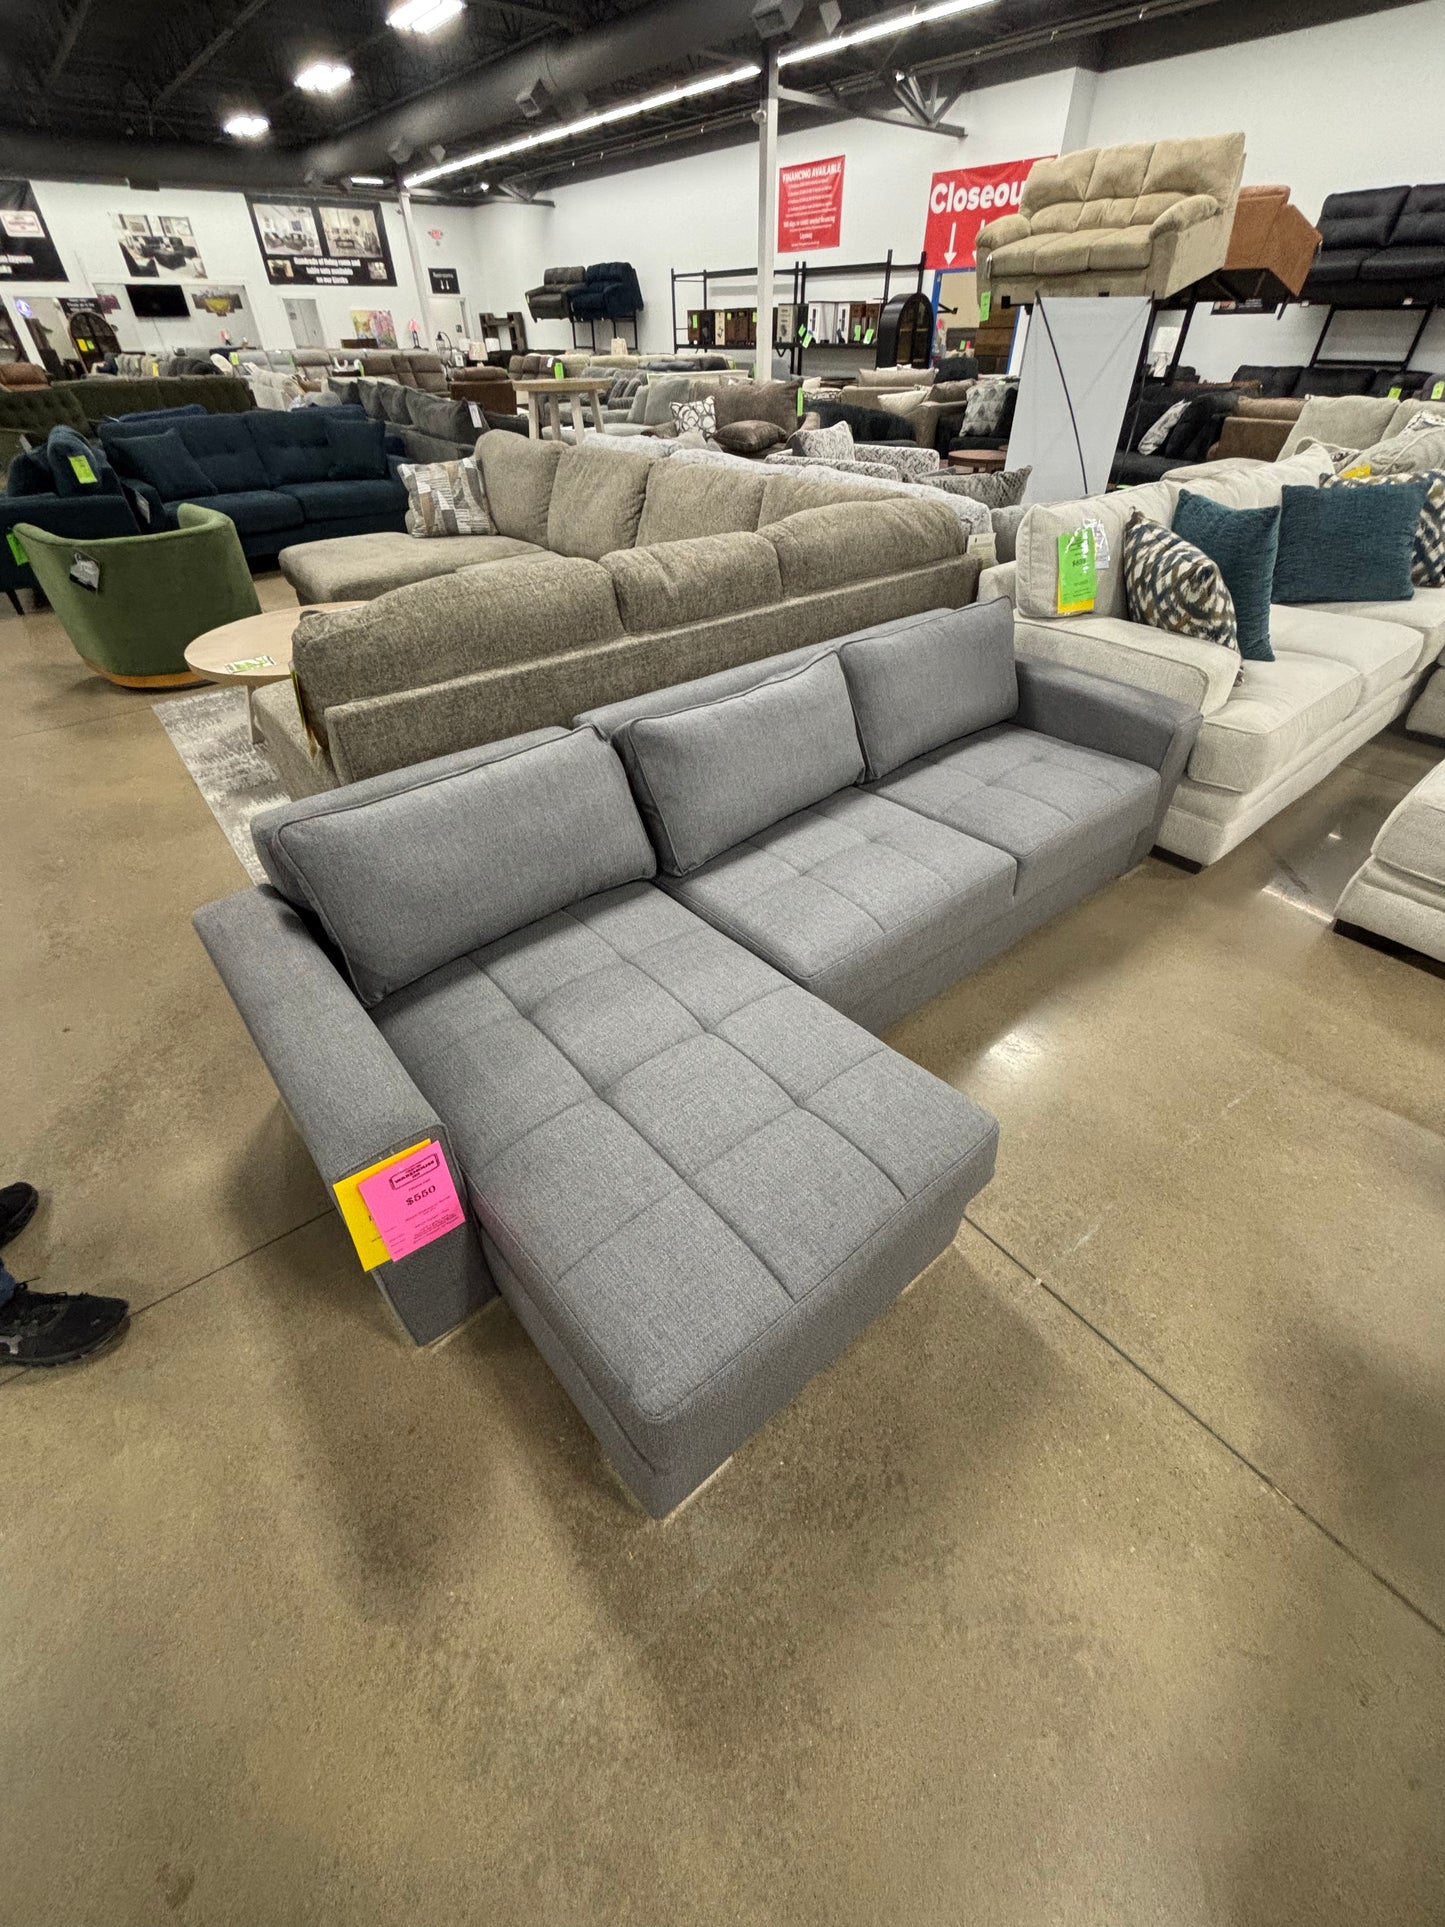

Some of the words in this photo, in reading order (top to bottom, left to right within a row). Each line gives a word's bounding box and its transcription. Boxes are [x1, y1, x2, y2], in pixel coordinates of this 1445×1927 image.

[782, 169, 811, 183] FINANCING
[811, 162, 841, 177] AVAILABLE
[405, 1184, 436, 1206] $550
